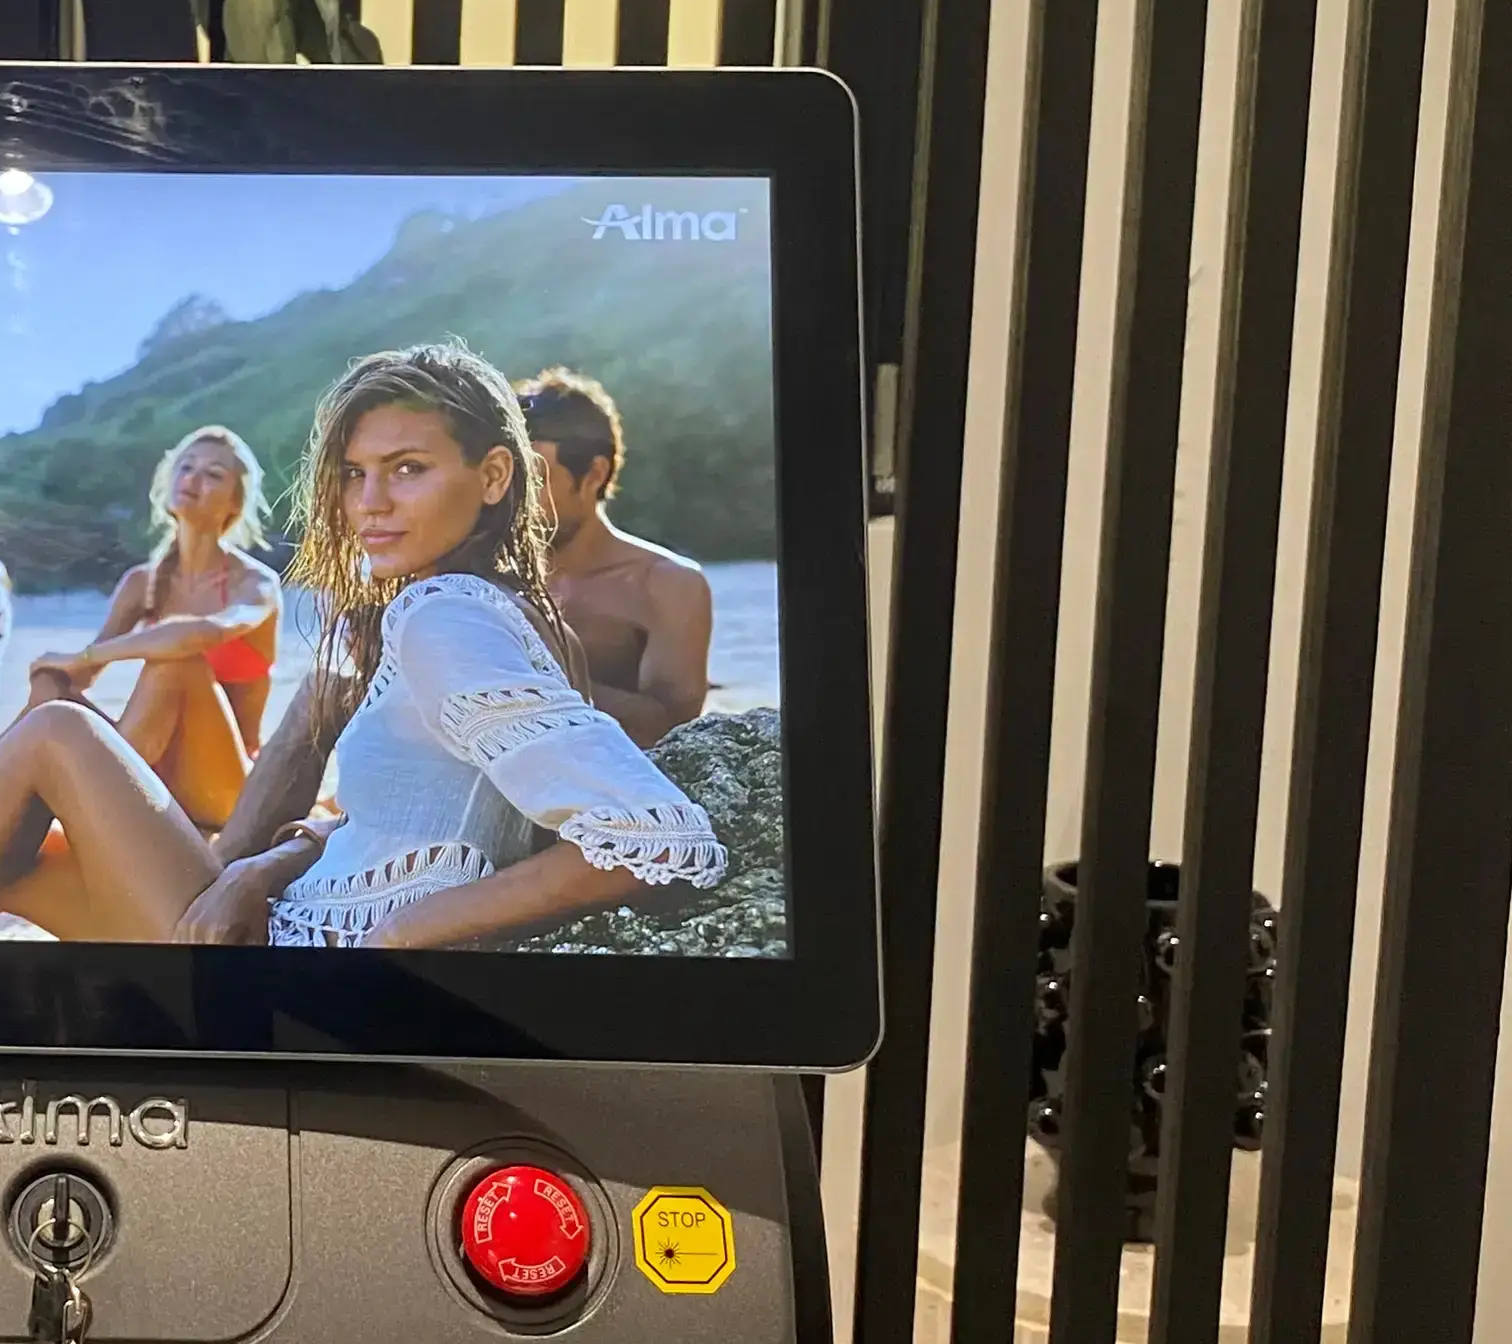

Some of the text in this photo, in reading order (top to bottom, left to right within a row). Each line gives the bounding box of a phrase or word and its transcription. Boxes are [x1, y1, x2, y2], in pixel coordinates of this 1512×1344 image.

[580, 203, 737, 242] Alma
[476, 1190, 500, 1233] RESET
[542, 1186, 575, 1223] RESET
[657, 1211, 707, 1228] STOP
[513, 1264, 556, 1280] RESET
